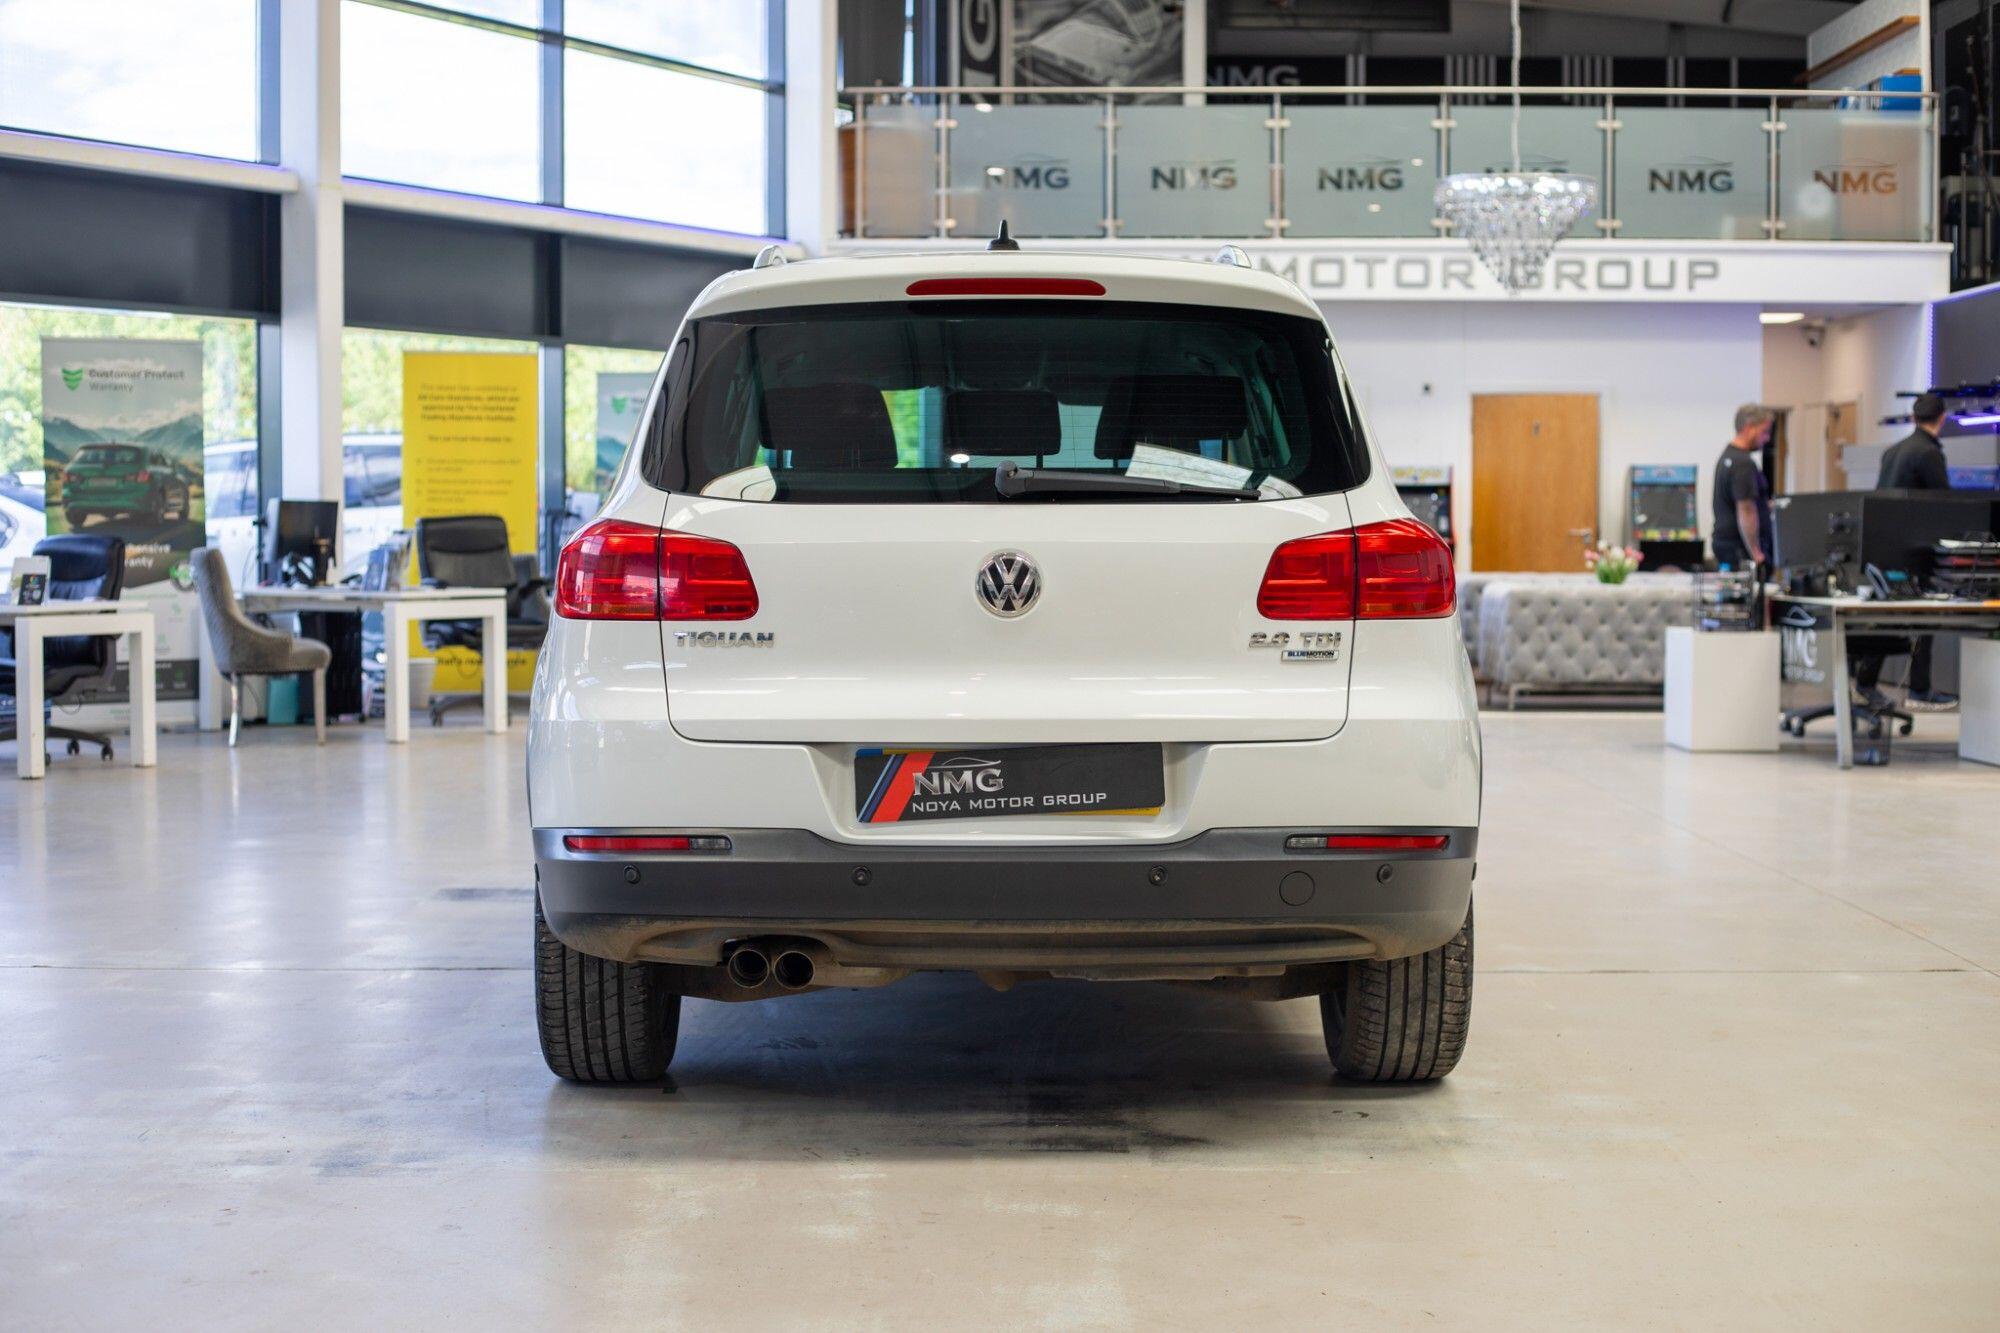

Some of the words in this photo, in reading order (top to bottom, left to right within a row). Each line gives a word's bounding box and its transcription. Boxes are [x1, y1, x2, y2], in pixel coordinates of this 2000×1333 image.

[1318, 167, 1403, 191] NMG
[1648, 169, 1733, 193] NMG
[1814, 170, 1897, 194] NMG
[1260, 257, 1475, 289] MOTOR
[673, 631, 775, 649] TIGUAN
[1300, 631, 1342, 648] TDI
[912, 767, 1004, 797] NMG
[912, 799, 962, 813] NOYA
[969, 796, 1034, 810] MOTOR
[1042, 792, 1107, 806] GROUP
